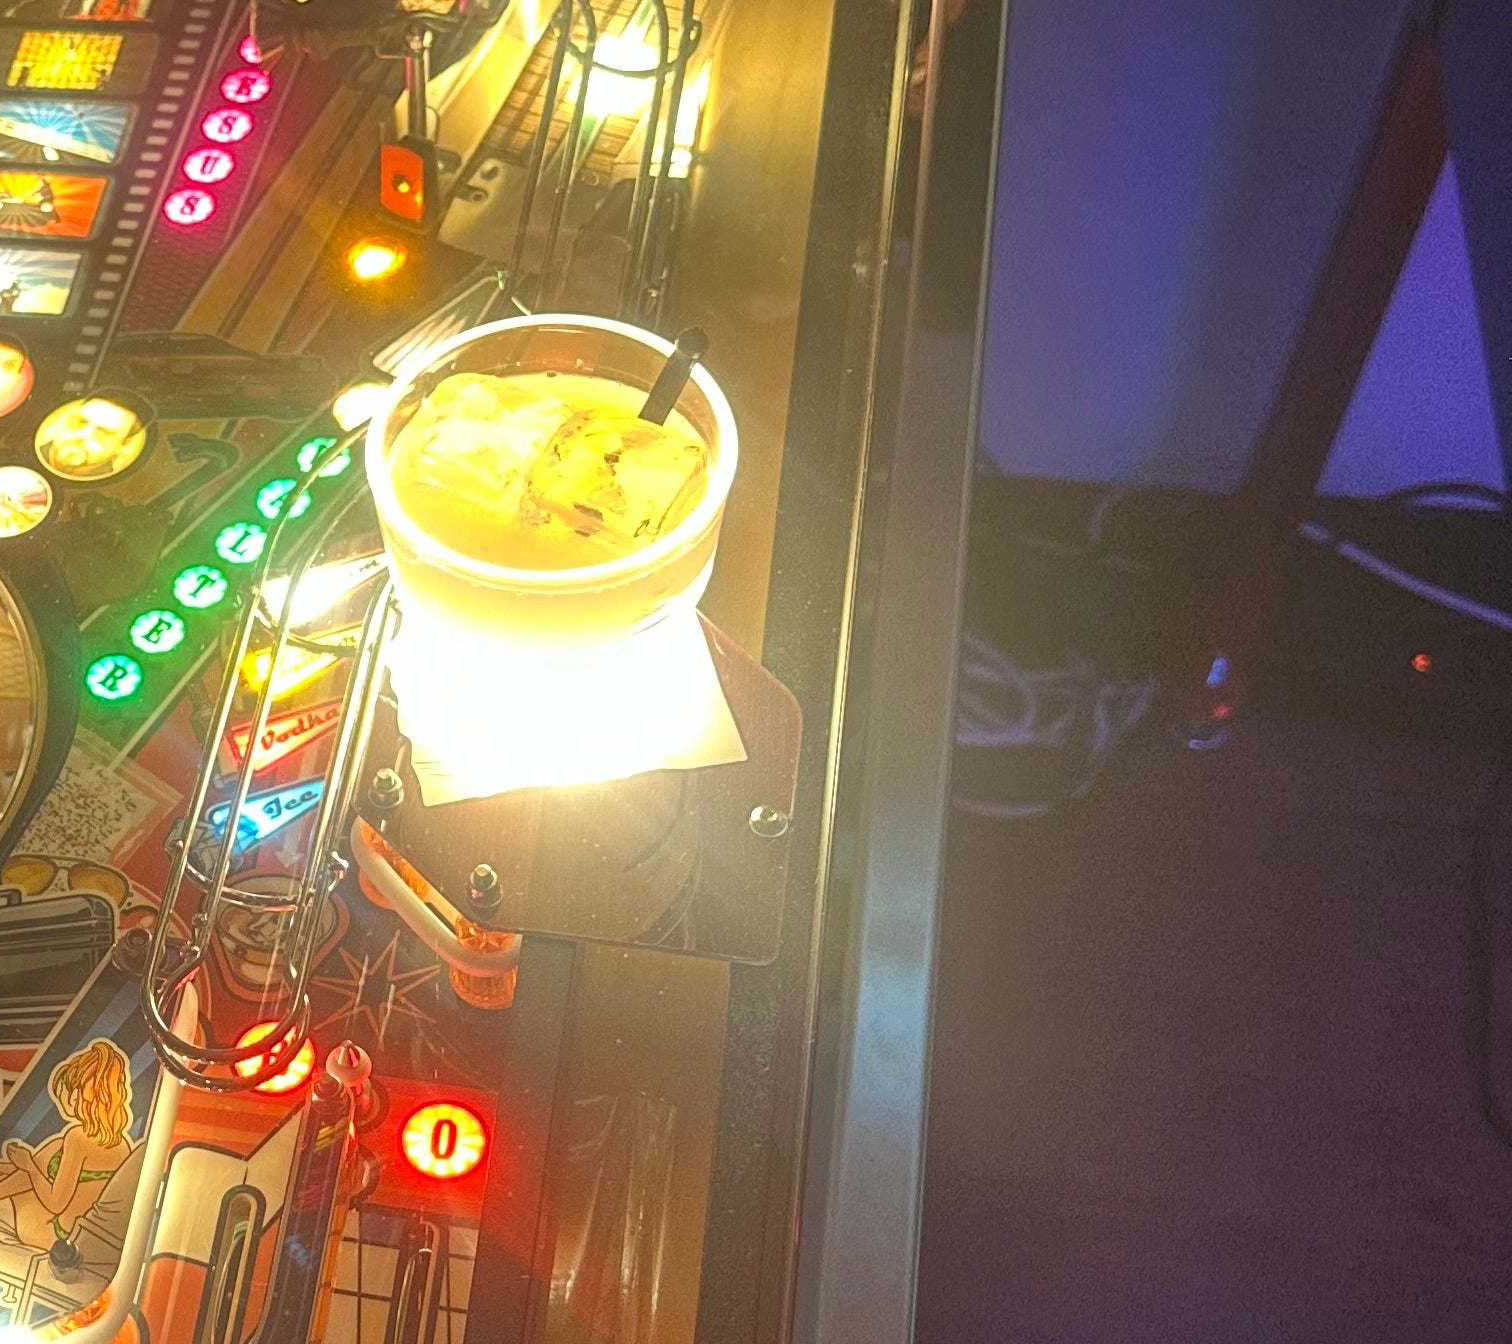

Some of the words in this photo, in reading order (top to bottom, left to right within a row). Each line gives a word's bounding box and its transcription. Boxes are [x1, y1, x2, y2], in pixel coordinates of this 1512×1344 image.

[260, 707, 341, 751] Vodka
[261, 788, 320, 821] Ice
[430, 1118, 458, 1160] 0
